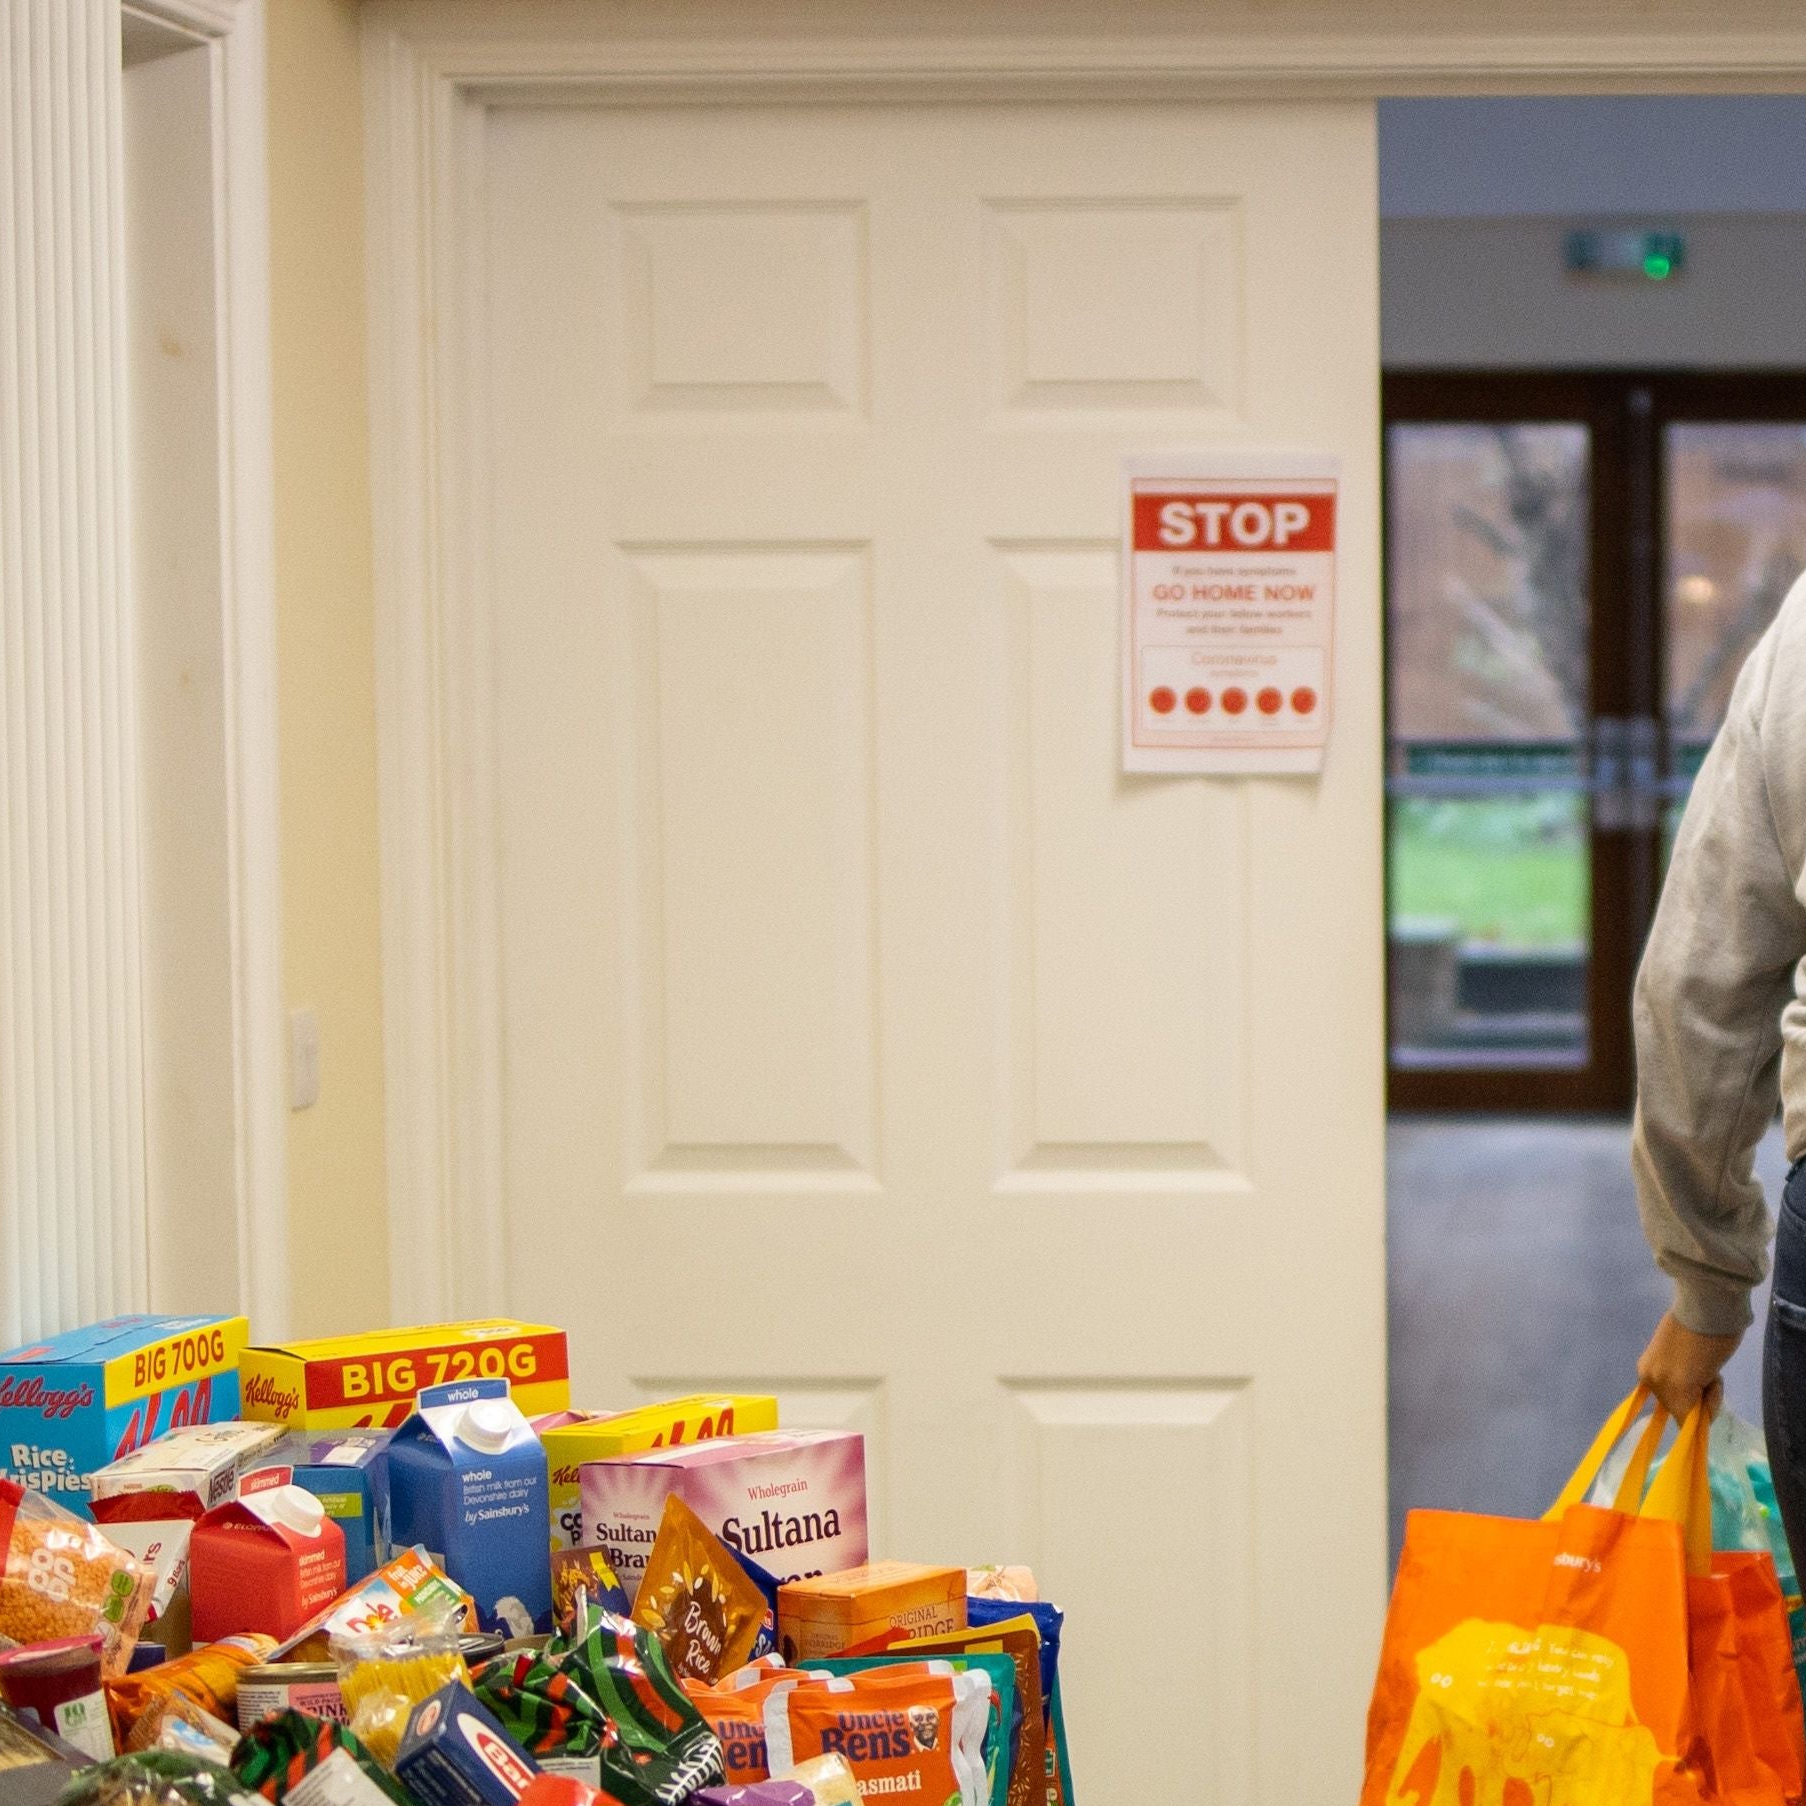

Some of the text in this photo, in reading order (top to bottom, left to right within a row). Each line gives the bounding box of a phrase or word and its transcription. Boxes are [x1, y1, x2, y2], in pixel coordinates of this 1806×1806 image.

[1158, 501, 1310, 545] STOP
[1152, 584, 1315, 601] GO HOME NOW
[1191, 652, 1277, 666] Coronavirus
[134, 1329, 225, 1387] BIG 700G
[343, 1344, 537, 1398] BIG 720G
[245, 1374, 299, 1419] Kellogg's
[447, 1388, 479, 1402] whole
[11, 1443, 68, 1468] Rice
[250, 1474, 279, 1491] skimmed
[461, 1470, 492, 1482] whole
[486, 1481, 503, 1491] milk
[504, 1479, 522, 1489] from
[524, 1477, 537, 1487] our
[464, 1488, 528, 1506] Devonshire dairy
[748, 1479, 808, 1501] Wholegrain
[465, 1503, 530, 1525] by Sainsbury's
[613, 1511, 650, 1521] Wholegrain
[596, 1523, 657, 1545] Sultan
[722, 1508, 841, 1556] Sultana
[299, 1550, 325, 1566] skimmed
[1553, 1552, 1602, 1574] sbury's
[309, 1587, 338, 1602] Sainsbury's
[890, 1606, 936, 1628] ORIGINAL
[684, 1600, 722, 1657] Brown
[685, 1644, 710, 1675] Rice
[838, 1710, 905, 1732] Uncle
[857, 1771, 922, 1797] asmati
